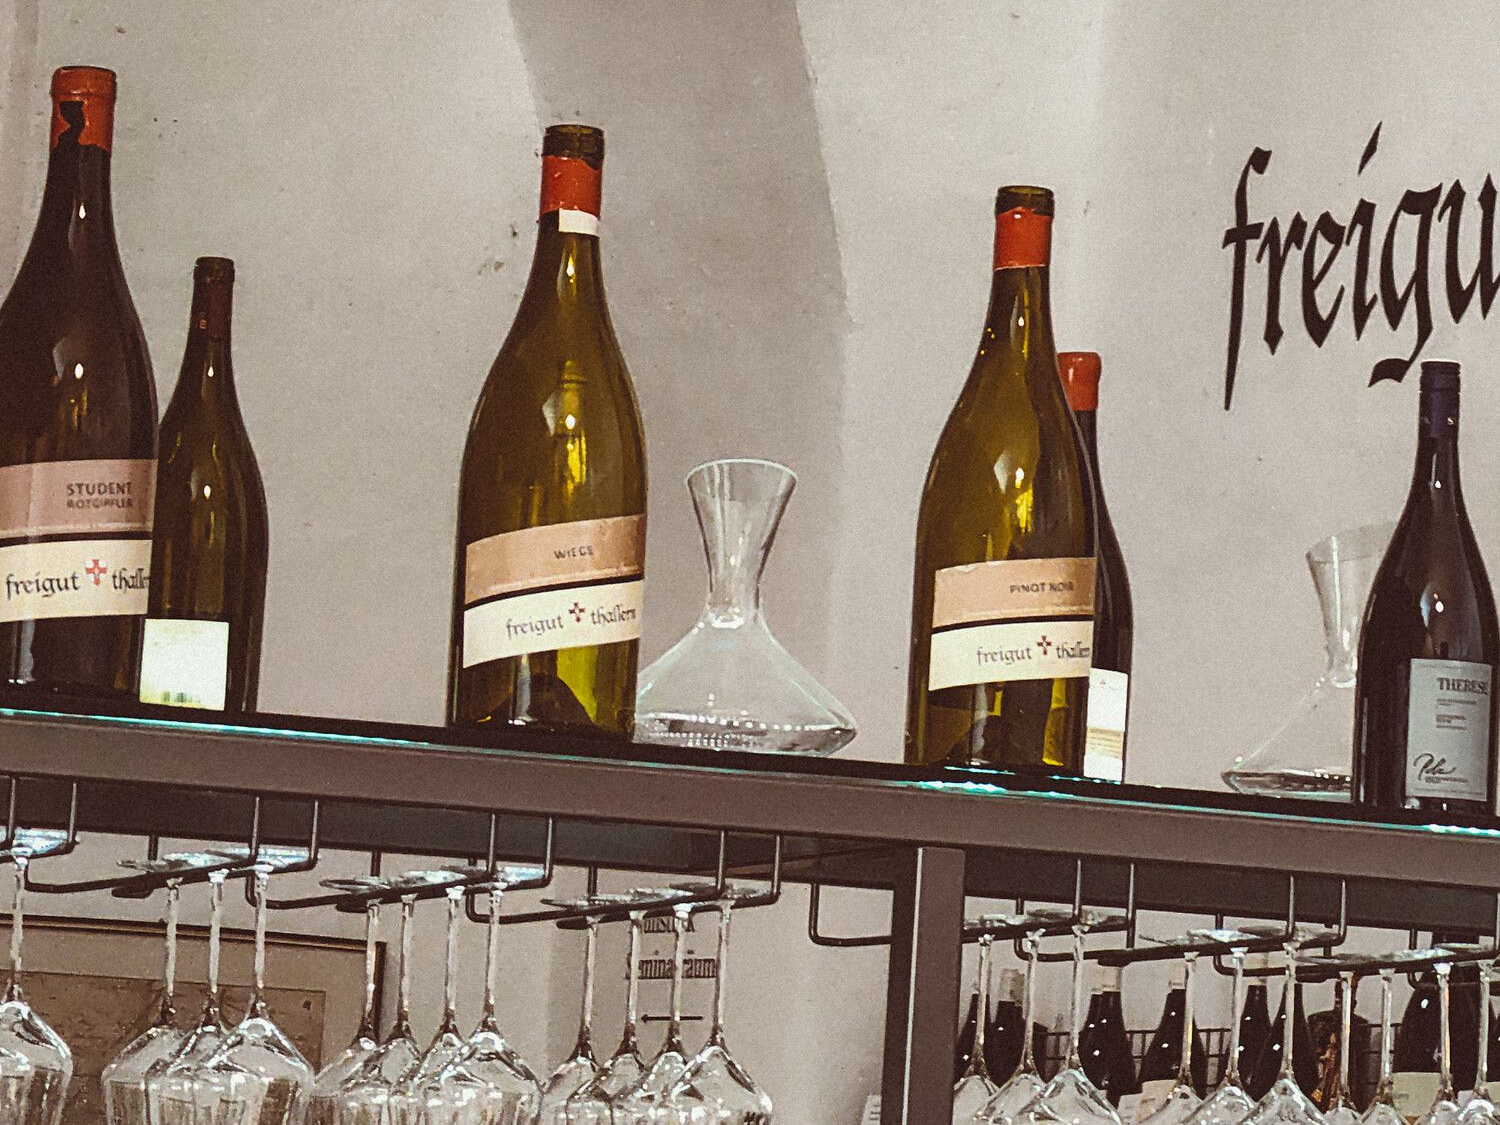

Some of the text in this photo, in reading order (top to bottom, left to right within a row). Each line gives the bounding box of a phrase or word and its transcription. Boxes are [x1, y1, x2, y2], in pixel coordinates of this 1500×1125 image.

[66, 480, 133, 496] STUDENT
[6, 571, 81, 601] freigut
[1009, 582, 1046, 594] PINOT
[505, 615, 564, 641] freigut
[976, 645, 1032, 666] freigut
